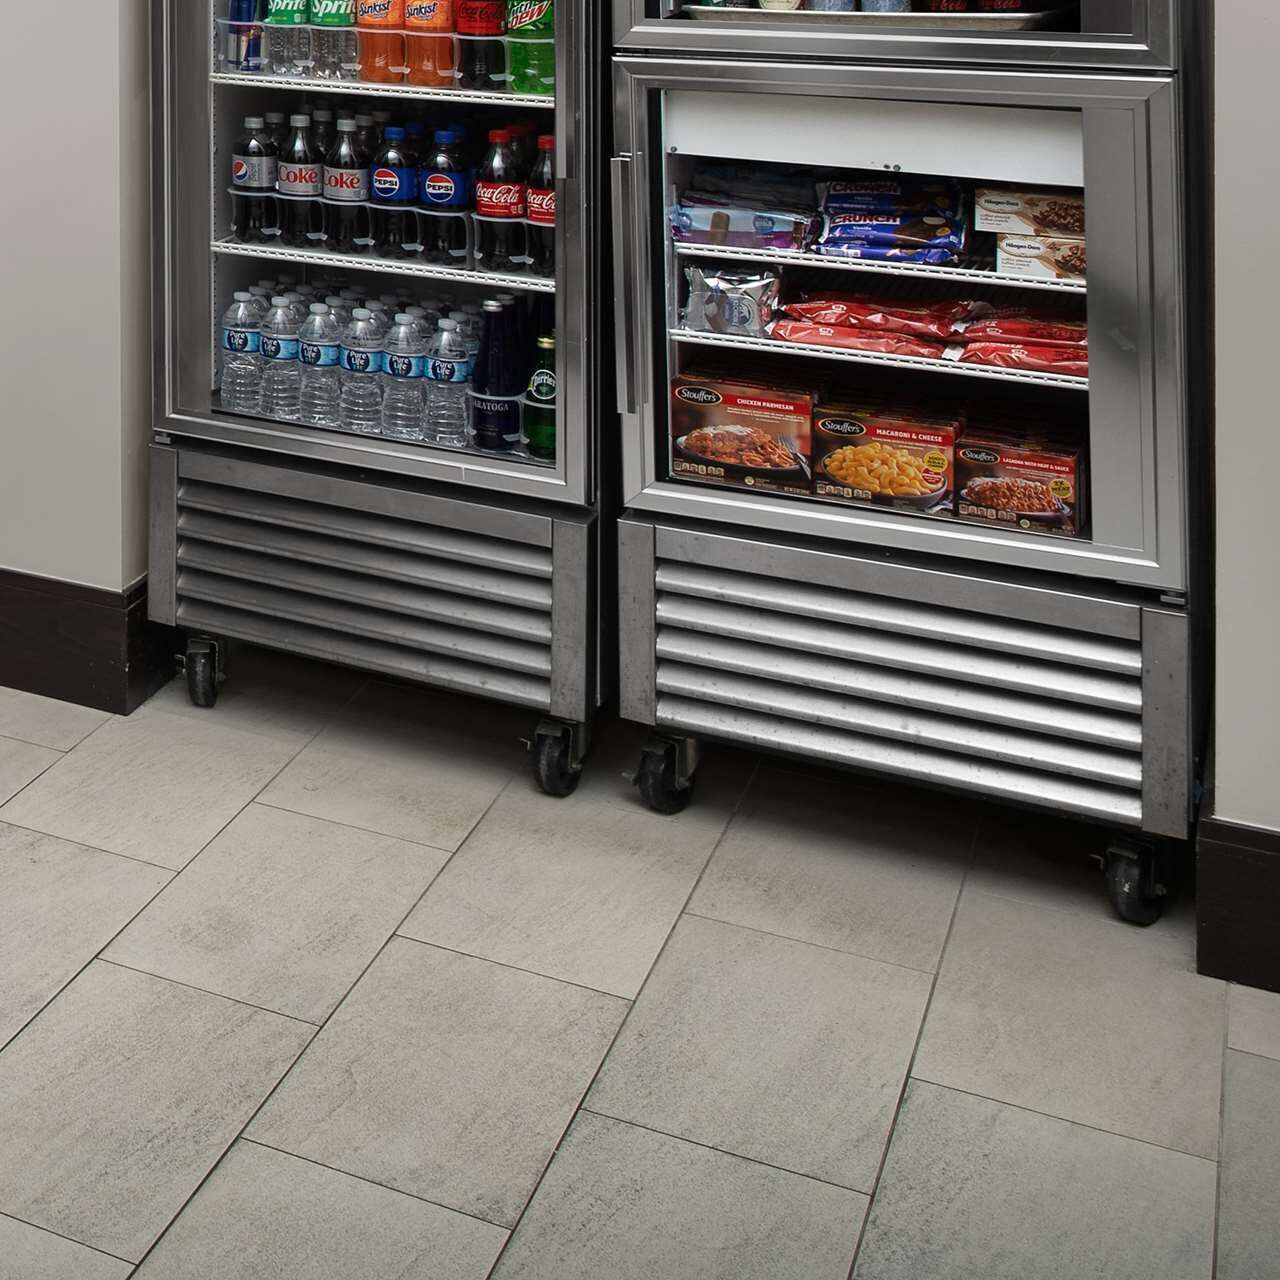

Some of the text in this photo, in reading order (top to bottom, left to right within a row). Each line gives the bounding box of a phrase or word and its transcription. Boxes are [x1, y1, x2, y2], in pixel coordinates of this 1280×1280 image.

[406, 0, 439, 18] Sunkist
[279, 166, 318, 185] Coke
[373, 178, 399, 189] PEPSI
[427, 183, 454, 193] PEPSI
[228, 332, 245, 342] Pure
[264, 339, 280, 349] Pure
[302, 345, 318, 355] Pure
[349, 350, 368, 361] Pure
[390, 355, 410, 366] Pure
[434, 360, 452, 371] Pure
[681, 388, 718, 403] Stouffer's
[737, 397, 794, 411] CHICKEN PARMESAN
[824, 420, 861, 434] Stouffer's
[876, 428, 910, 439] MACARONI
[918, 433, 942, 443] CHEESE
[965, 450, 996, 462] Stouffer's
